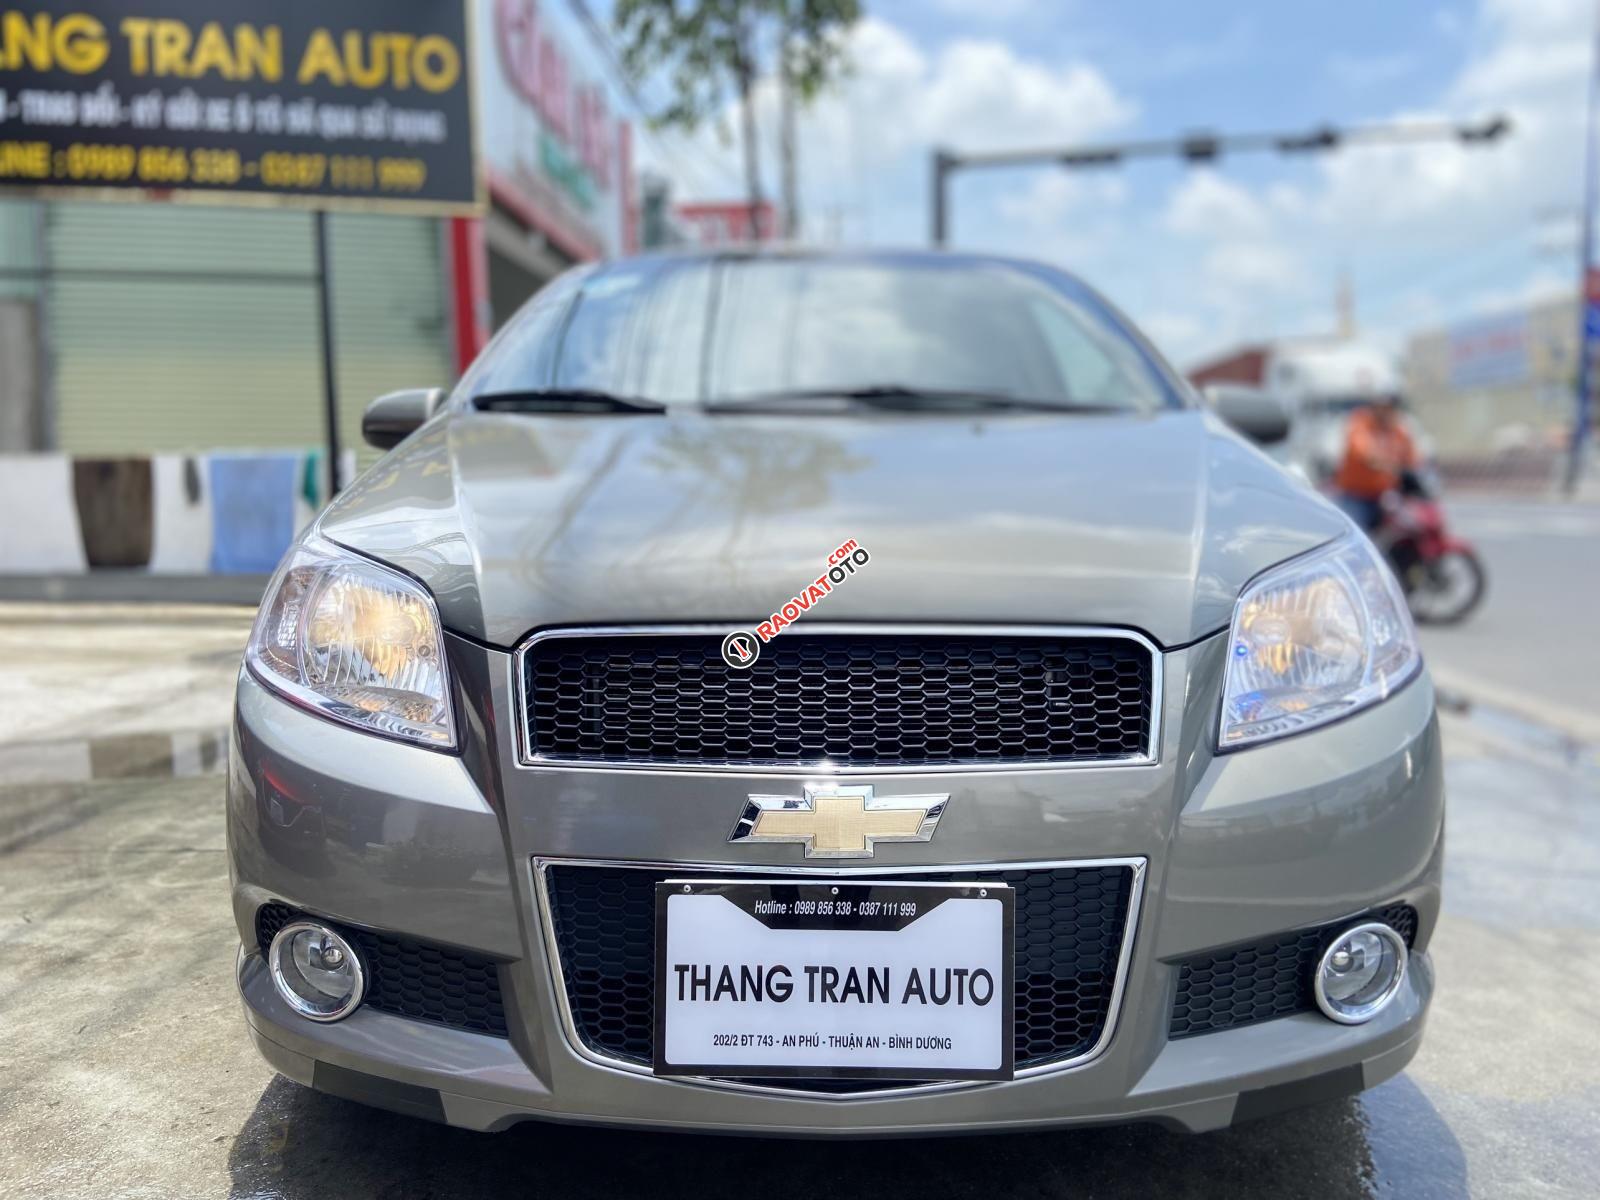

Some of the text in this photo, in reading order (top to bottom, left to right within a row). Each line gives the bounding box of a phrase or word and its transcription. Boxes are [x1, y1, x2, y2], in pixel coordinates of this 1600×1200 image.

[120, 16, 282, 82] TRAN
[298, 28, 461, 93] AUTO
[67, 142, 136, 180] 0989
[754, 900, 787, 914] Hotline
[794, 901, 816, 915] 0989
[817, 901, 834, 915] 856
[835, 901, 851, 915] 338
[859, 902, 881, 916] 0387
[883, 902, 898, 916] 111
[900, 902, 917, 917] 999
[674, 964, 994, 1006] THANG TRAN AUTO
[713, 1034, 738, 1047] 202/2
[741, 1034, 754, 1047] ĐT
[757, 1035, 774, 1047] 743
[782, 1035, 796, 1047] AN
[798, 1032, 820, 1048] PHÚ
[828, 1033, 863, 1051] THUẬN
[865, 1036, 880, 1048] AN
[888, 1034, 913, 1049] BÌNH
[915, 1035, 952, 1050] DƯƠNG
